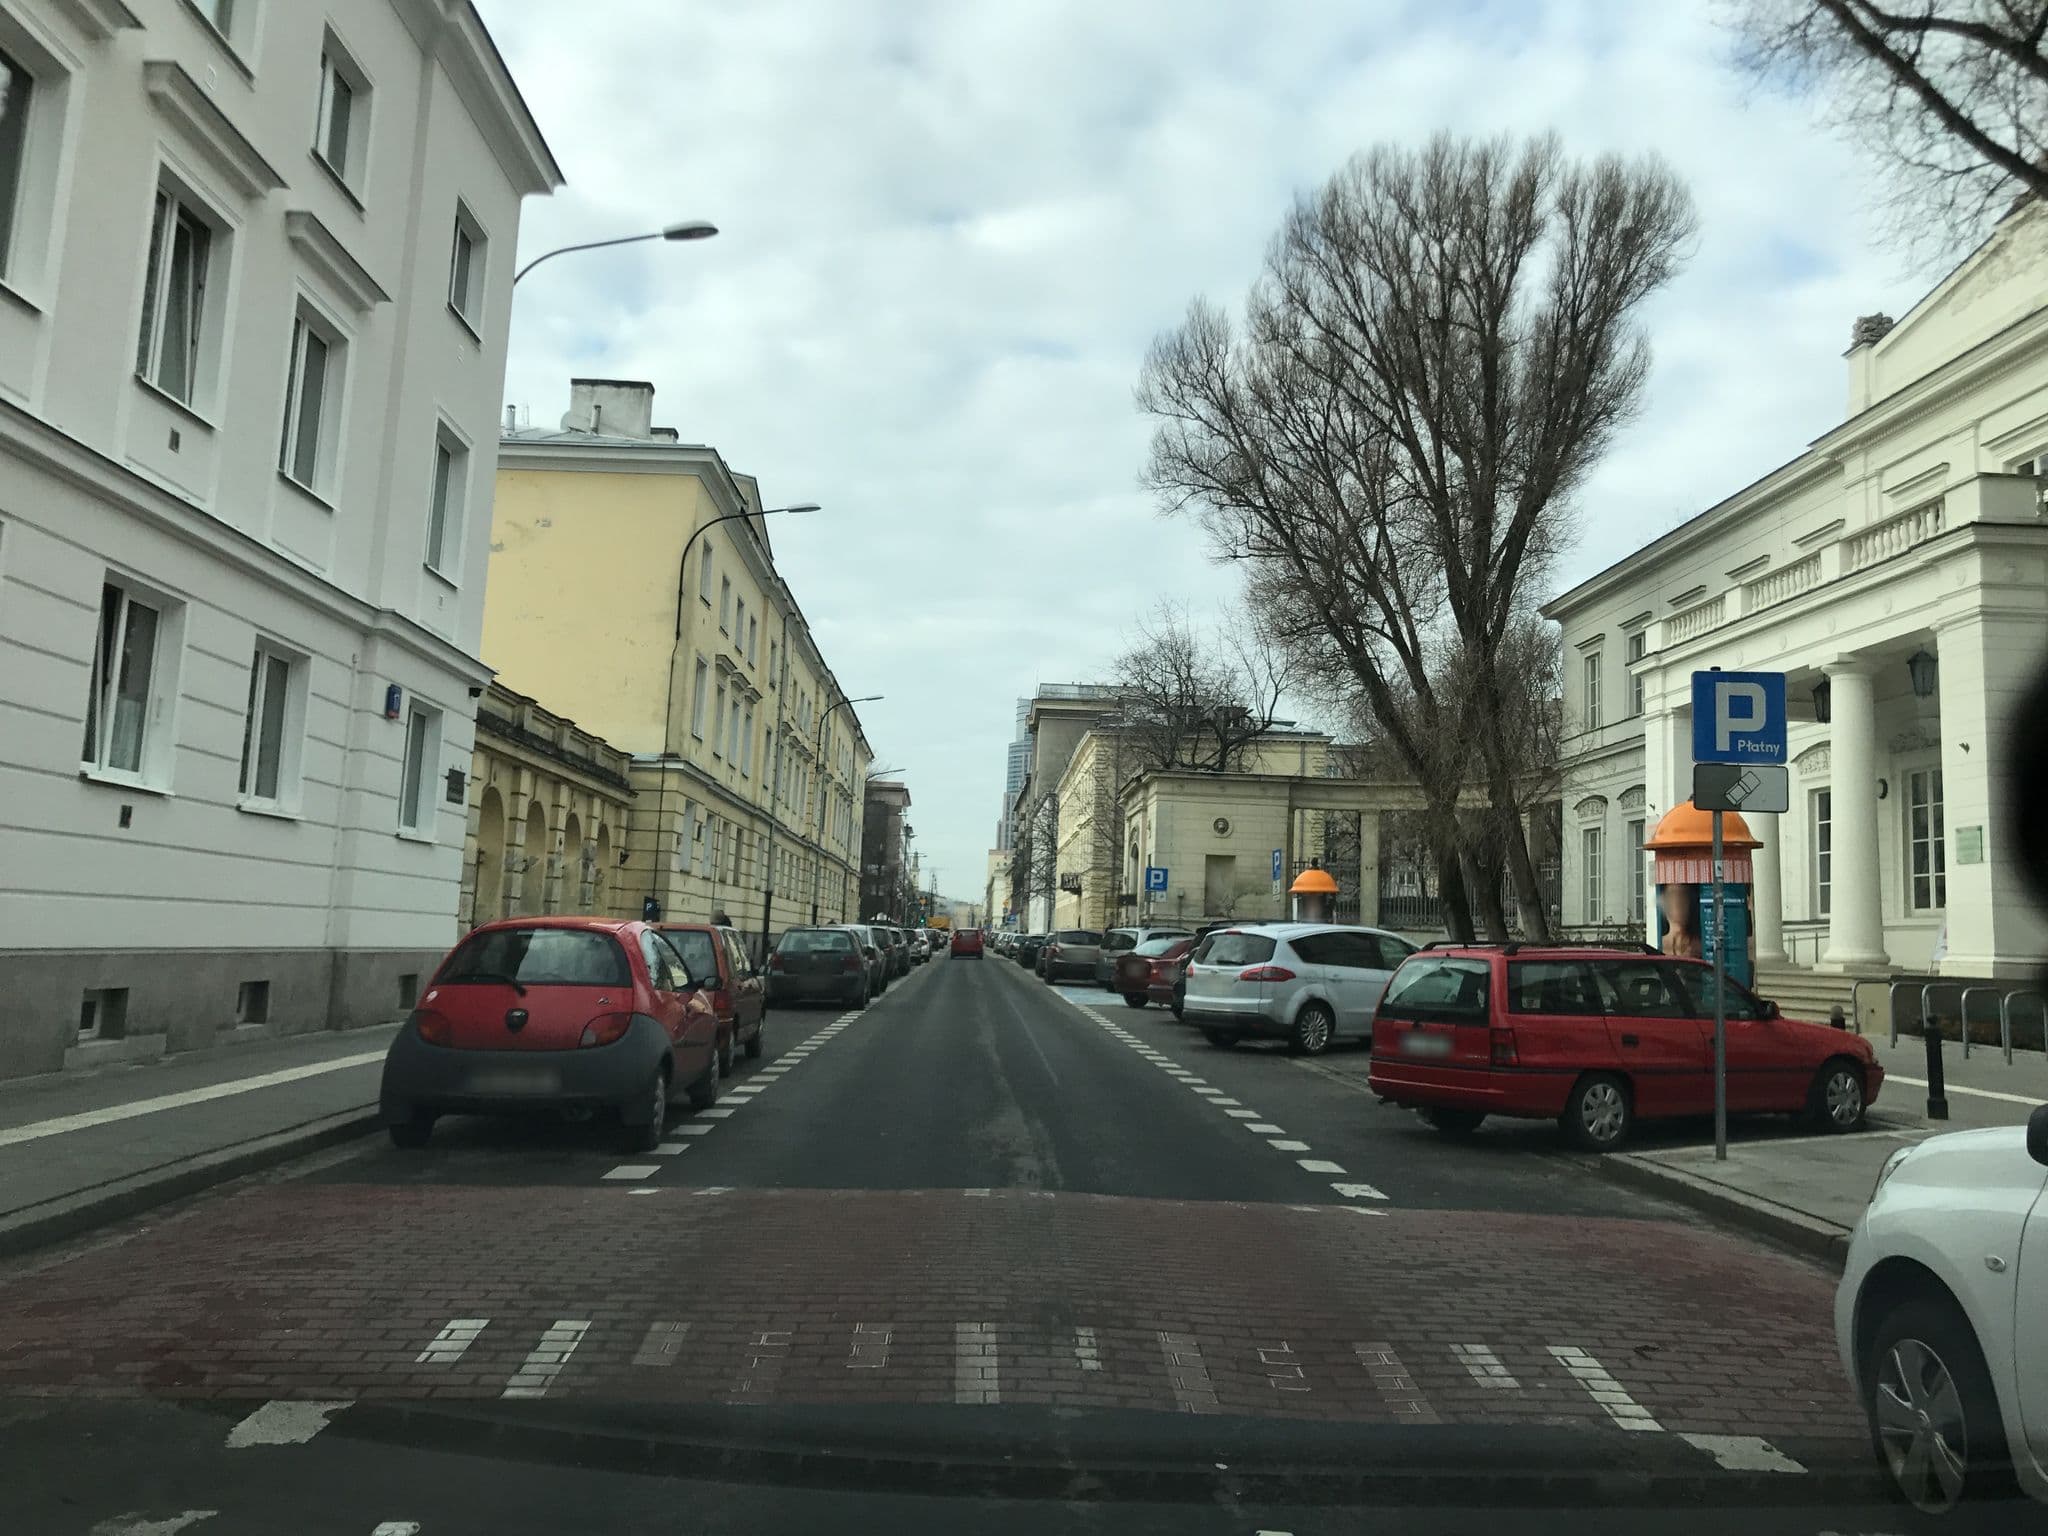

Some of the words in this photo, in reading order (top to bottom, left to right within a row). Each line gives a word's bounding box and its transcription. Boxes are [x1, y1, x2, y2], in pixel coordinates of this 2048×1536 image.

[1715, 682, 1766, 751] P
[1737, 739, 1780, 757] Płatny
[1274, 851, 1280, 872] P
[1150, 870, 1164, 888] P
[646, 902, 653, 911] P
